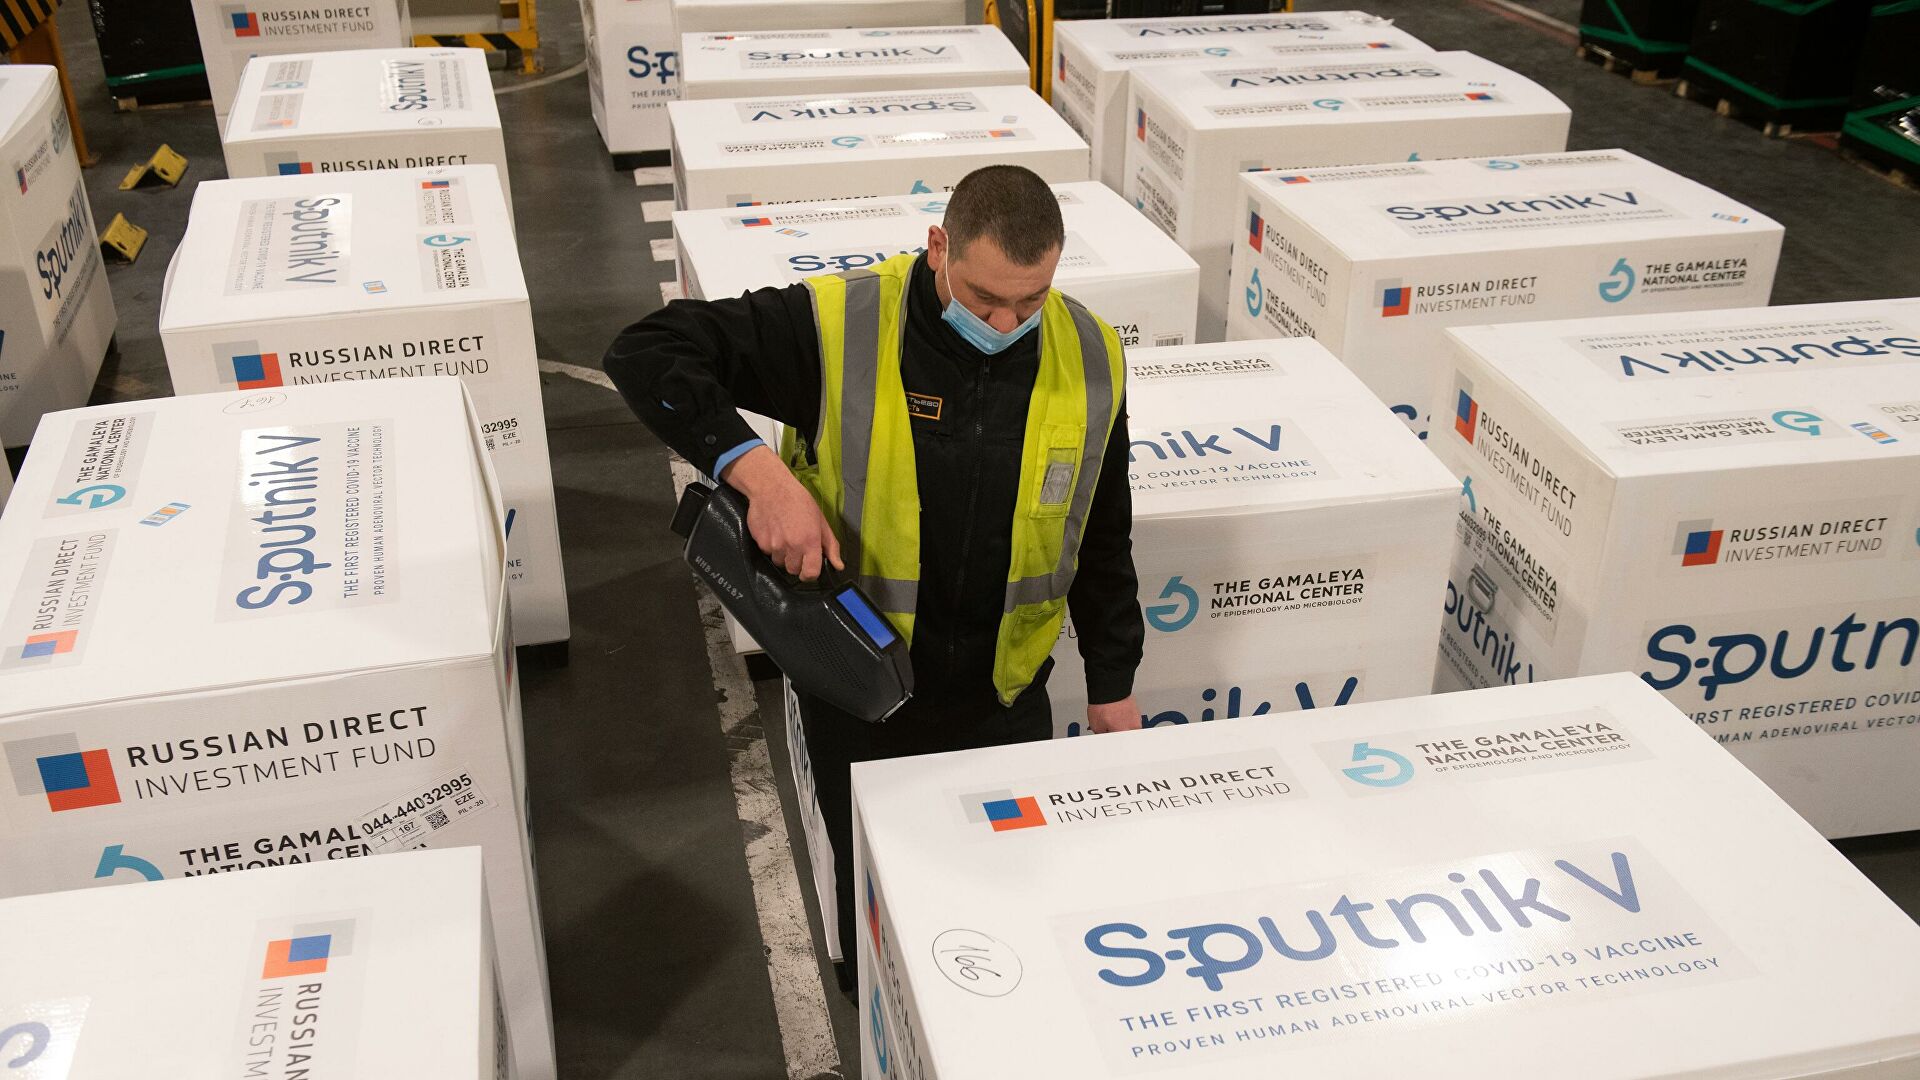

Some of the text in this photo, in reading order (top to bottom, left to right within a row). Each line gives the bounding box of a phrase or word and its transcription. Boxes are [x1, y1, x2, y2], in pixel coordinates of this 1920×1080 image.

[262, 6, 371, 22] RUSSIAN DIRECT
[264, 20, 374, 36] INVESTMENT FUND
[748, 48, 912, 62] Sputnik
[920, 46, 946, 55] V
[1230, 68, 1442, 87] Sputnik V
[751, 101, 976, 122] Sputnik V
[320, 155, 468, 174] RUSSIAN DIRECT
[1386, 191, 1639, 222] Sputnik V
[1438, 221, 1472, 229] FIRST
[36, 196, 84, 300] Sputnik
[282, 198, 341, 284] Sputnik V
[1266, 225, 1329, 285] RUSSIAN DIRECT
[1646, 258, 1748, 274] THE GAMALEYA
[1264, 245, 1327, 308] INVESTMENT FUND
[1417, 276, 1538, 298] RUSSIAN DIRECT
[1642, 270, 1747, 286] NATIONAL CENTER
[1266, 288, 1279, 308] THE
[1281, 301, 1317, 340] GAMALEYA
[1415, 293, 1537, 315] INVESTMENT FUND
[1265, 302, 1292, 334] NATIONAL
[1589, 340, 1652, 350] VACCINE
[1657, 336, 1725, 346] COVID-19
[1729, 331, 1816, 341] REGISTERED
[289, 336, 484, 368] RUSSIAN DIRECT
[1131, 358, 1267, 372] THE GAMALEYA
[1620, 335, 1920, 376] Sputnik V
[433, 358, 490, 377] FUND
[1134, 367, 1206, 377] NATIONAL
[1209, 363, 1272, 373] CENTER
[503, 432, 517, 440] EZE
[1232, 424, 1281, 451] V
[1621, 427, 1684, 438] CENTER
[1630, 427, 1776, 445] THE GAMALEYA
[1686, 419, 1767, 433] NATIONAL
[77, 419, 109, 484] THE GAMALEYA
[95, 417, 126, 482] NATIONAL CENTER
[255, 435, 321, 455] V
[1147, 459, 1312, 480] COVID-19 VACCINE
[1481, 411, 1577, 510] RUSSIAN DIRECT
[1161, 478, 1219, 488] VECTOR
[1224, 470, 1319, 483] TECHNOLOGY
[1476, 434, 1573, 537] INVESTMENT FUND
[344, 426, 361, 598] THE FIRST REGISTERED COVID-19 VACCINE
[372, 425, 385, 596] PROVEN HUMAN ADENOVIRAL VECTOR TECHNOLOGY
[236, 456, 332, 610] Sputnik
[1730, 517, 1888, 543] RUSSIAN DIRECT
[1483, 507, 1502, 536] THE
[1504, 529, 1558, 597] GAMALEYA
[1725, 537, 1882, 563] INVESTMENT FUND
[33, 539, 79, 631] RUSSIAN DIRECT
[62, 534, 106, 626] INVESTMENT FUND
[1213, 568, 1365, 595] THE GAMALEYA
[1522, 569, 1556, 614] CENTER
[1211, 583, 1364, 610] NATIONAL CENTER
[1224, 605, 1282, 618] EPIDEMIOLOGY
[1284, 603, 1301, 611] AND
[1303, 597, 1363, 609] MICROBIOLOGY
[1739, 696, 1857, 721] REGISTERED
[126, 706, 428, 768] RUSSIAN DIRECT
[1416, 722, 1614, 754] THE GAMALEYA
[1760, 720, 1859, 740] ADENOVIRAL
[1425, 733, 1625, 766] NATIONAL CENTER
[1452, 756, 1528, 771] EPIDEMIOLOGY
[1531, 752, 1553, 761] AND
[1555, 743, 1632, 758] MICROBIOLOGY
[134, 737, 436, 800] INVESTMENT FUND
[455, 792, 475, 806] EZE
[1048, 765, 1277, 806] RUSSIAN DIRECT
[362, 773, 472, 835] 044-44032995
[473, 800, 484, 808] -20
[1056, 780, 1291, 824] INVESTMENT FUND
[381, 835, 387, 843] 1
[398, 821, 415, 834] 167
[179, 843, 242, 866] THE
[1084, 851, 1641, 992] Sputnik V
[1119, 932, 1703, 1032] THE FIRST REGISTERED COVID-19 VACCINE
[1131, 957, 1721, 1058] PROVEN HUMAN ADENOVIRAL VECTOR TECHNOLOGY
[285, 983, 323, 1080] RUSSIAN
